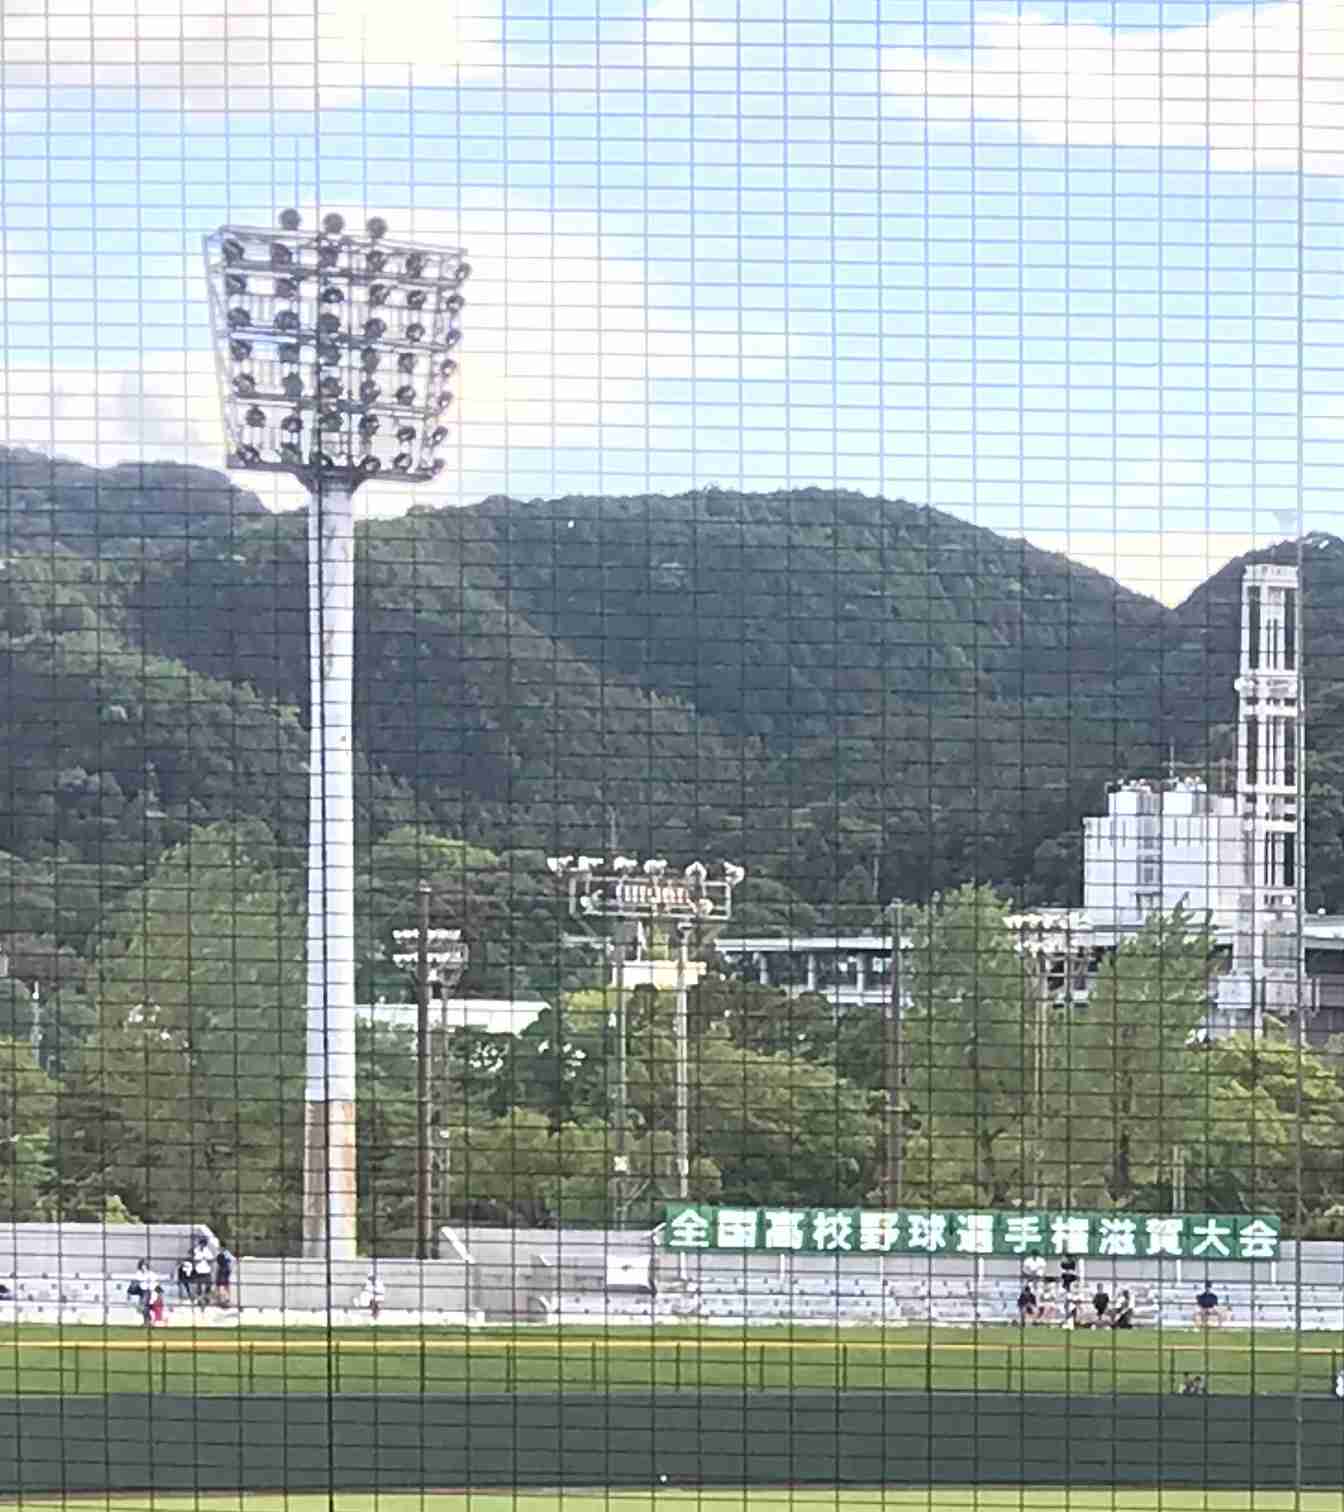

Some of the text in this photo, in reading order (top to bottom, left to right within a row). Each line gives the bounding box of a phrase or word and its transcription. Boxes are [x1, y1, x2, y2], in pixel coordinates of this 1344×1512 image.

[668, 1208, 1277, 1257] 全国高校野球選手権滋賀大会
